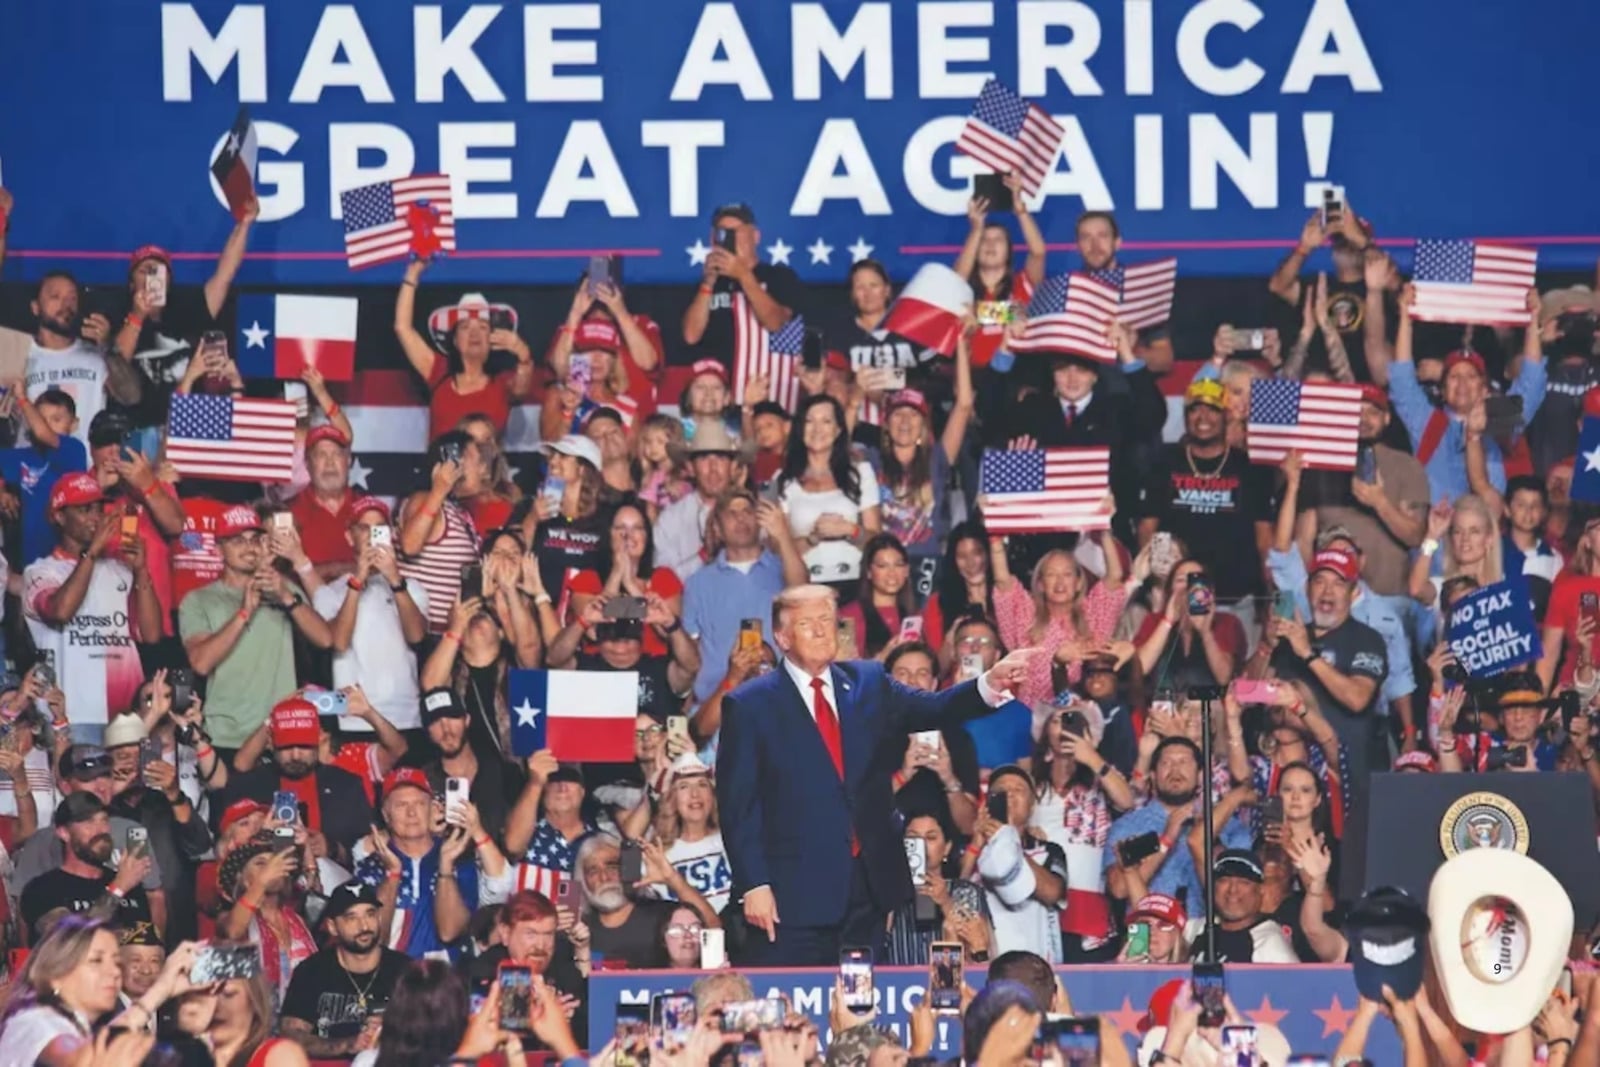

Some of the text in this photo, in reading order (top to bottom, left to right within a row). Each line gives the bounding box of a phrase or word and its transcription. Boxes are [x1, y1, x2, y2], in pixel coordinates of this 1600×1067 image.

[161, 0, 1382, 104] MAKE AMERICA
[208, 112, 1334, 222] GREAT AGAIN!
[1178, 488, 1232, 503] VANCE
[1451, 589, 1513, 629] NO TAX
[1473, 616, 1500, 631] ON
[1451, 621, 1519, 657] SOCIAL
